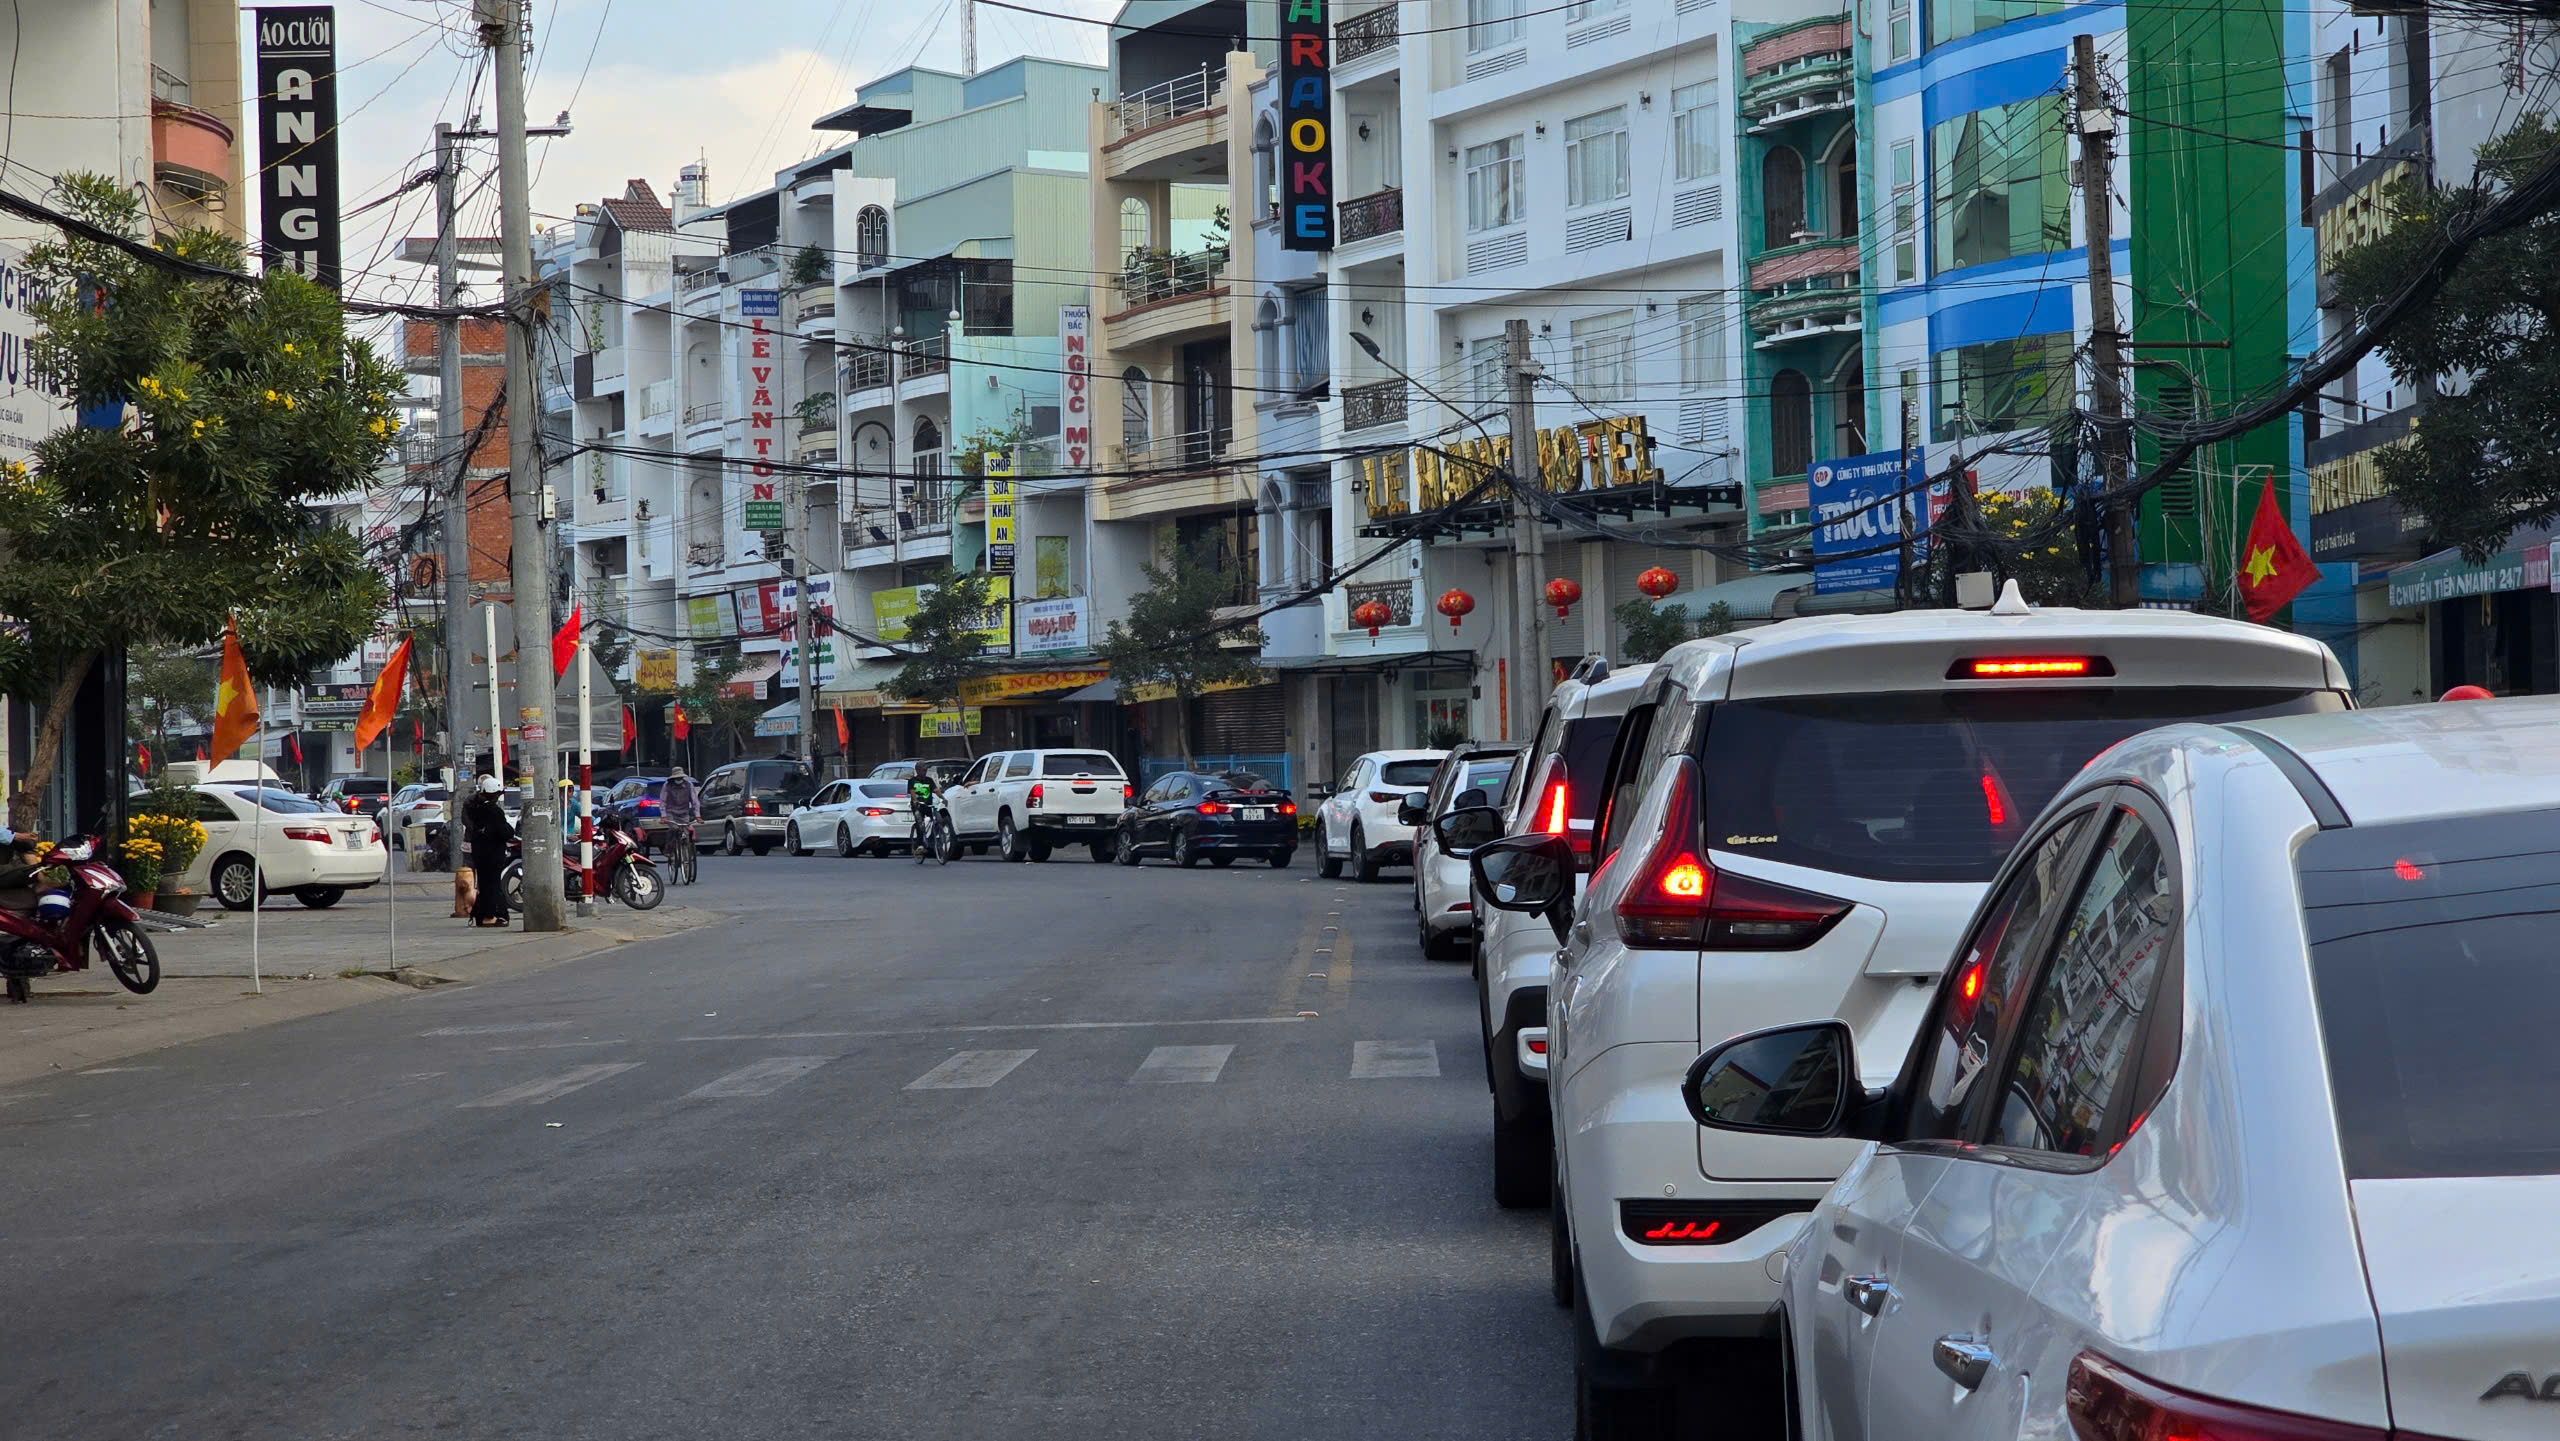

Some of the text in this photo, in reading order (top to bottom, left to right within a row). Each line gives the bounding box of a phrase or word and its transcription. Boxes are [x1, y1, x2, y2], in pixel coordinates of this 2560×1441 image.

[260, 16, 330, 46] ÁO CƯỚI
[1065, 309, 1086, 318] THUỐC
[1067, 319, 1083, 330] BẮC
[752, 367, 773, 428] VĂN
[1066, 335, 1088, 467] NGỌC MỸ
[753, 438, 774, 500] TÔN
[990, 458, 1012, 473] SHOP
[1853, 468, 1861, 479] TY
[1894, 460, 1912, 471] PHM
[996, 527, 1009, 541] AN
[2396, 572, 2433, 606] CHUYỂN
[2434, 569, 2457, 599] TIỀN
[2456, 570, 2496, 595] NHANH
[2499, 566, 2523, 589] 24/7
